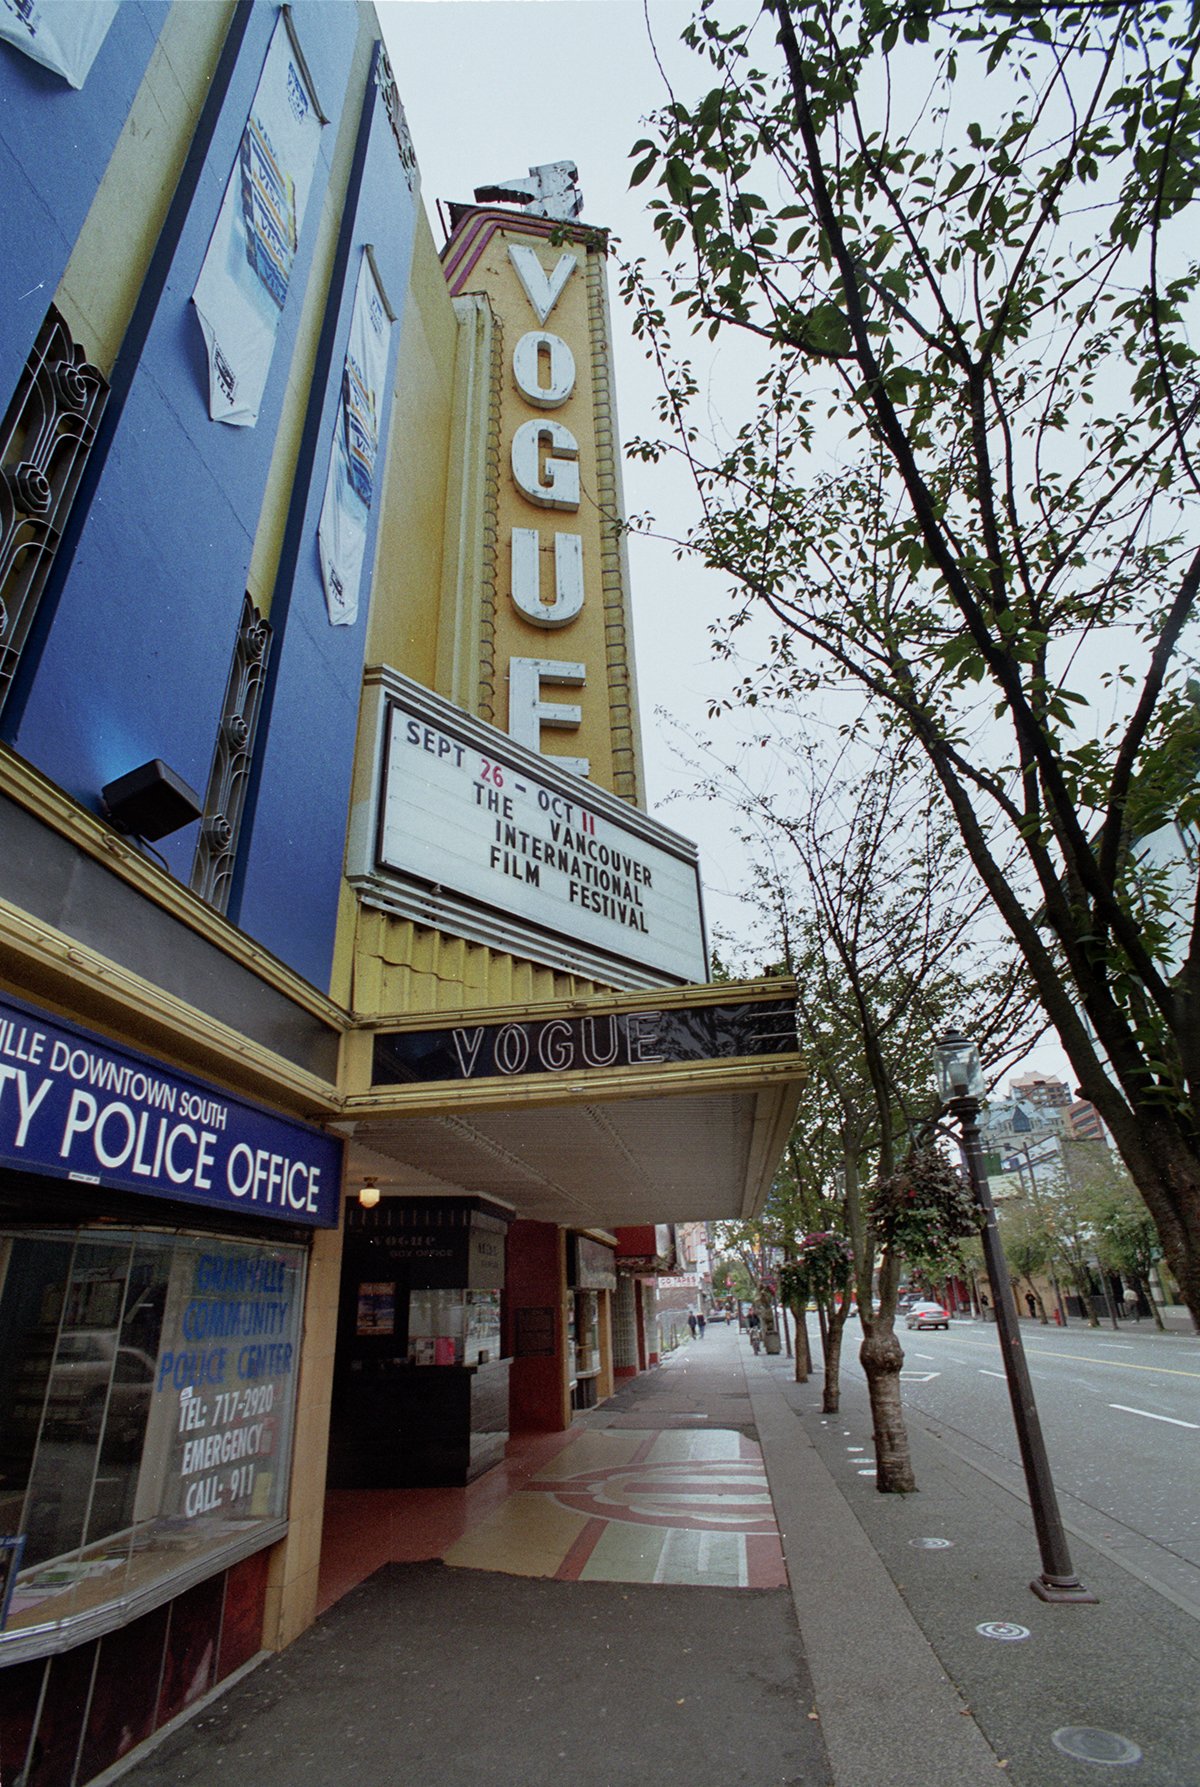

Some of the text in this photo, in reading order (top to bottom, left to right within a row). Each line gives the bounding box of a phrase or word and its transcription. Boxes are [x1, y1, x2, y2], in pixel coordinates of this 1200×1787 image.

[507, 243, 590, 777] VOGUE
[407, 721, 465, 767] SEPT
[480, 758, 504, 788] 26
[538, 789, 573, 824] OCT
[582, 811, 595, 836] 11
[473, 781, 652, 888] THE VANCOUVER
[496, 819, 643, 907] INTERNATIONAL
[490, 845, 649, 934] FILM FESTIVAL
[0, 1018, 228, 1130] ILLE DOWNTOWN SOUTH
[452, 1011, 666, 1079] VOGUE
[60, 1088, 218, 1189] POLICE
[227, 1142, 321, 1213] OFFICE
[197, 1254, 286, 1293] GRANVILLE
[182, 1300, 289, 1340] COMMUNITY
[157, 1346, 228, 1392] POLICE
[212, 1384, 273, 1427] 717-2920
[181, 1423, 264, 1476] EMERGENCY
[230, 1463, 255, 1502] 911
